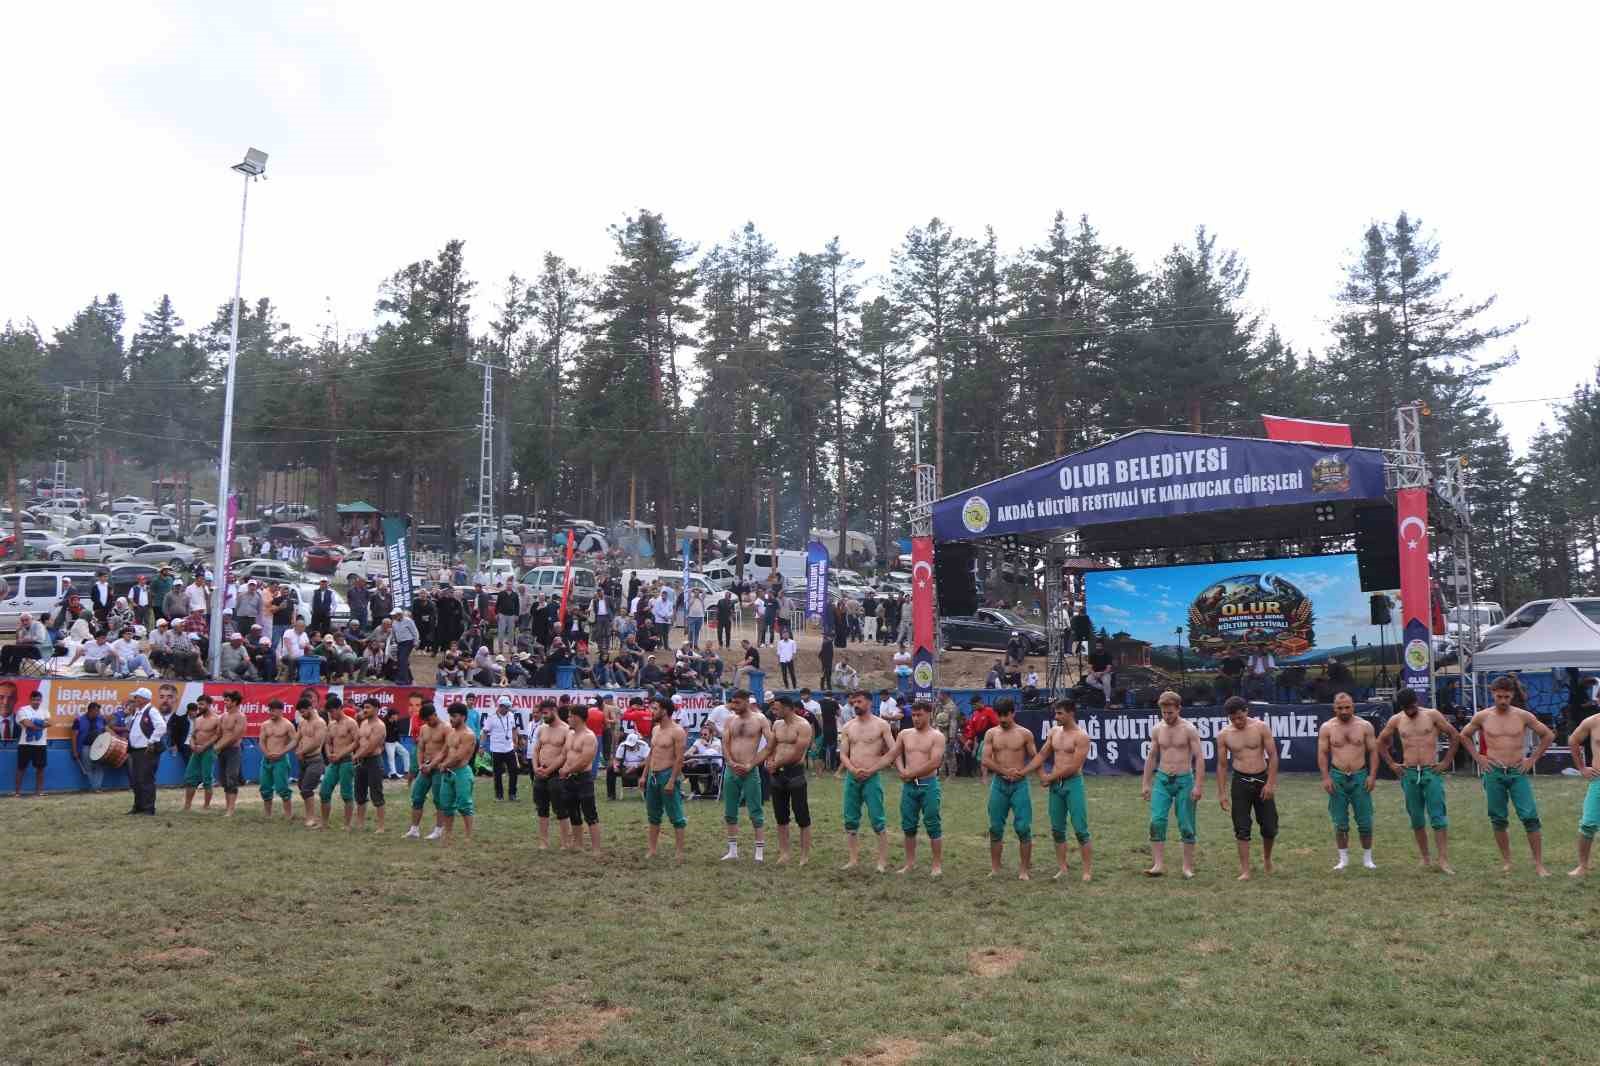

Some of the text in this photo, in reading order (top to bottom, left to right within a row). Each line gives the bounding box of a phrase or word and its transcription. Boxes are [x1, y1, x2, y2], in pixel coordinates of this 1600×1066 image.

[1059, 462, 1110, 491] OLUR
[997, 501, 1035, 522] AKDAĞ
[1037, 495, 1079, 517] KÜLTÜR
[1141, 487, 1157, 505] VE
[1159, 478, 1232, 503] KARAKUCAK
[1234, 469, 1303, 495] GÜREŞLERİ
[1221, 601, 1280, 616] OLUR
[57, 686, 118, 701] İBRAHİM
